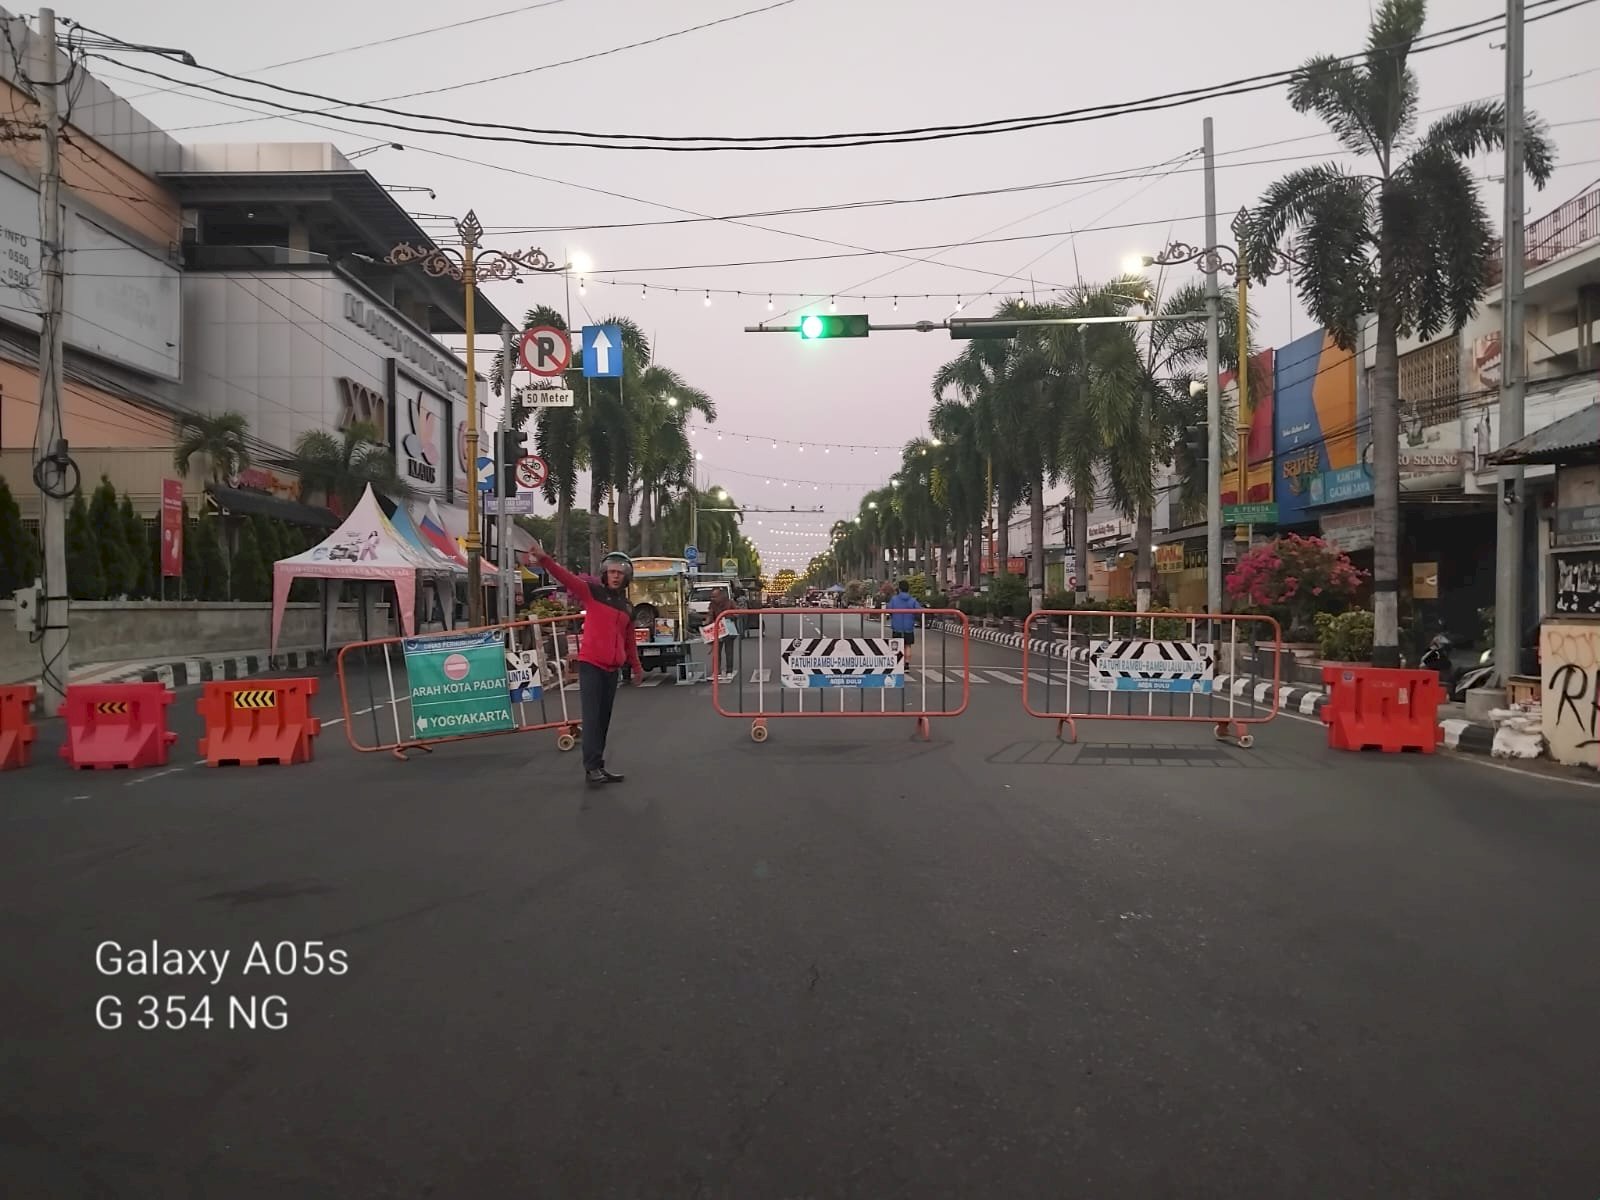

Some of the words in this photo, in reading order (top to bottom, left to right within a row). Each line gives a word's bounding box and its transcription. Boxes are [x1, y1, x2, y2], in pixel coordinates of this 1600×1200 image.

[527, 393, 538, 404] 50
[540, 392, 569, 403] Meter
[1413, 455, 1458, 465] SENENG
[791, 657, 813, 668] PATUHI
[813, 657, 859, 668] RAMBU-RAMBU
[859, 657, 873, 668] LALU
[874, 656, 895, 667] LINTAS
[1099, 659, 1121, 671] PATUHI
[1121, 660, 1167, 672] RAMBU-RAMBU
[1167, 660, 1182, 672] LALU
[1182, 660, 1203, 673] LINTAS
[412, 685, 441, 697] ARAH
[443, 682, 472, 694] KOTA
[473, 678, 507, 691] PADAT
[430, 709, 510, 728] YOGYAKARTA
